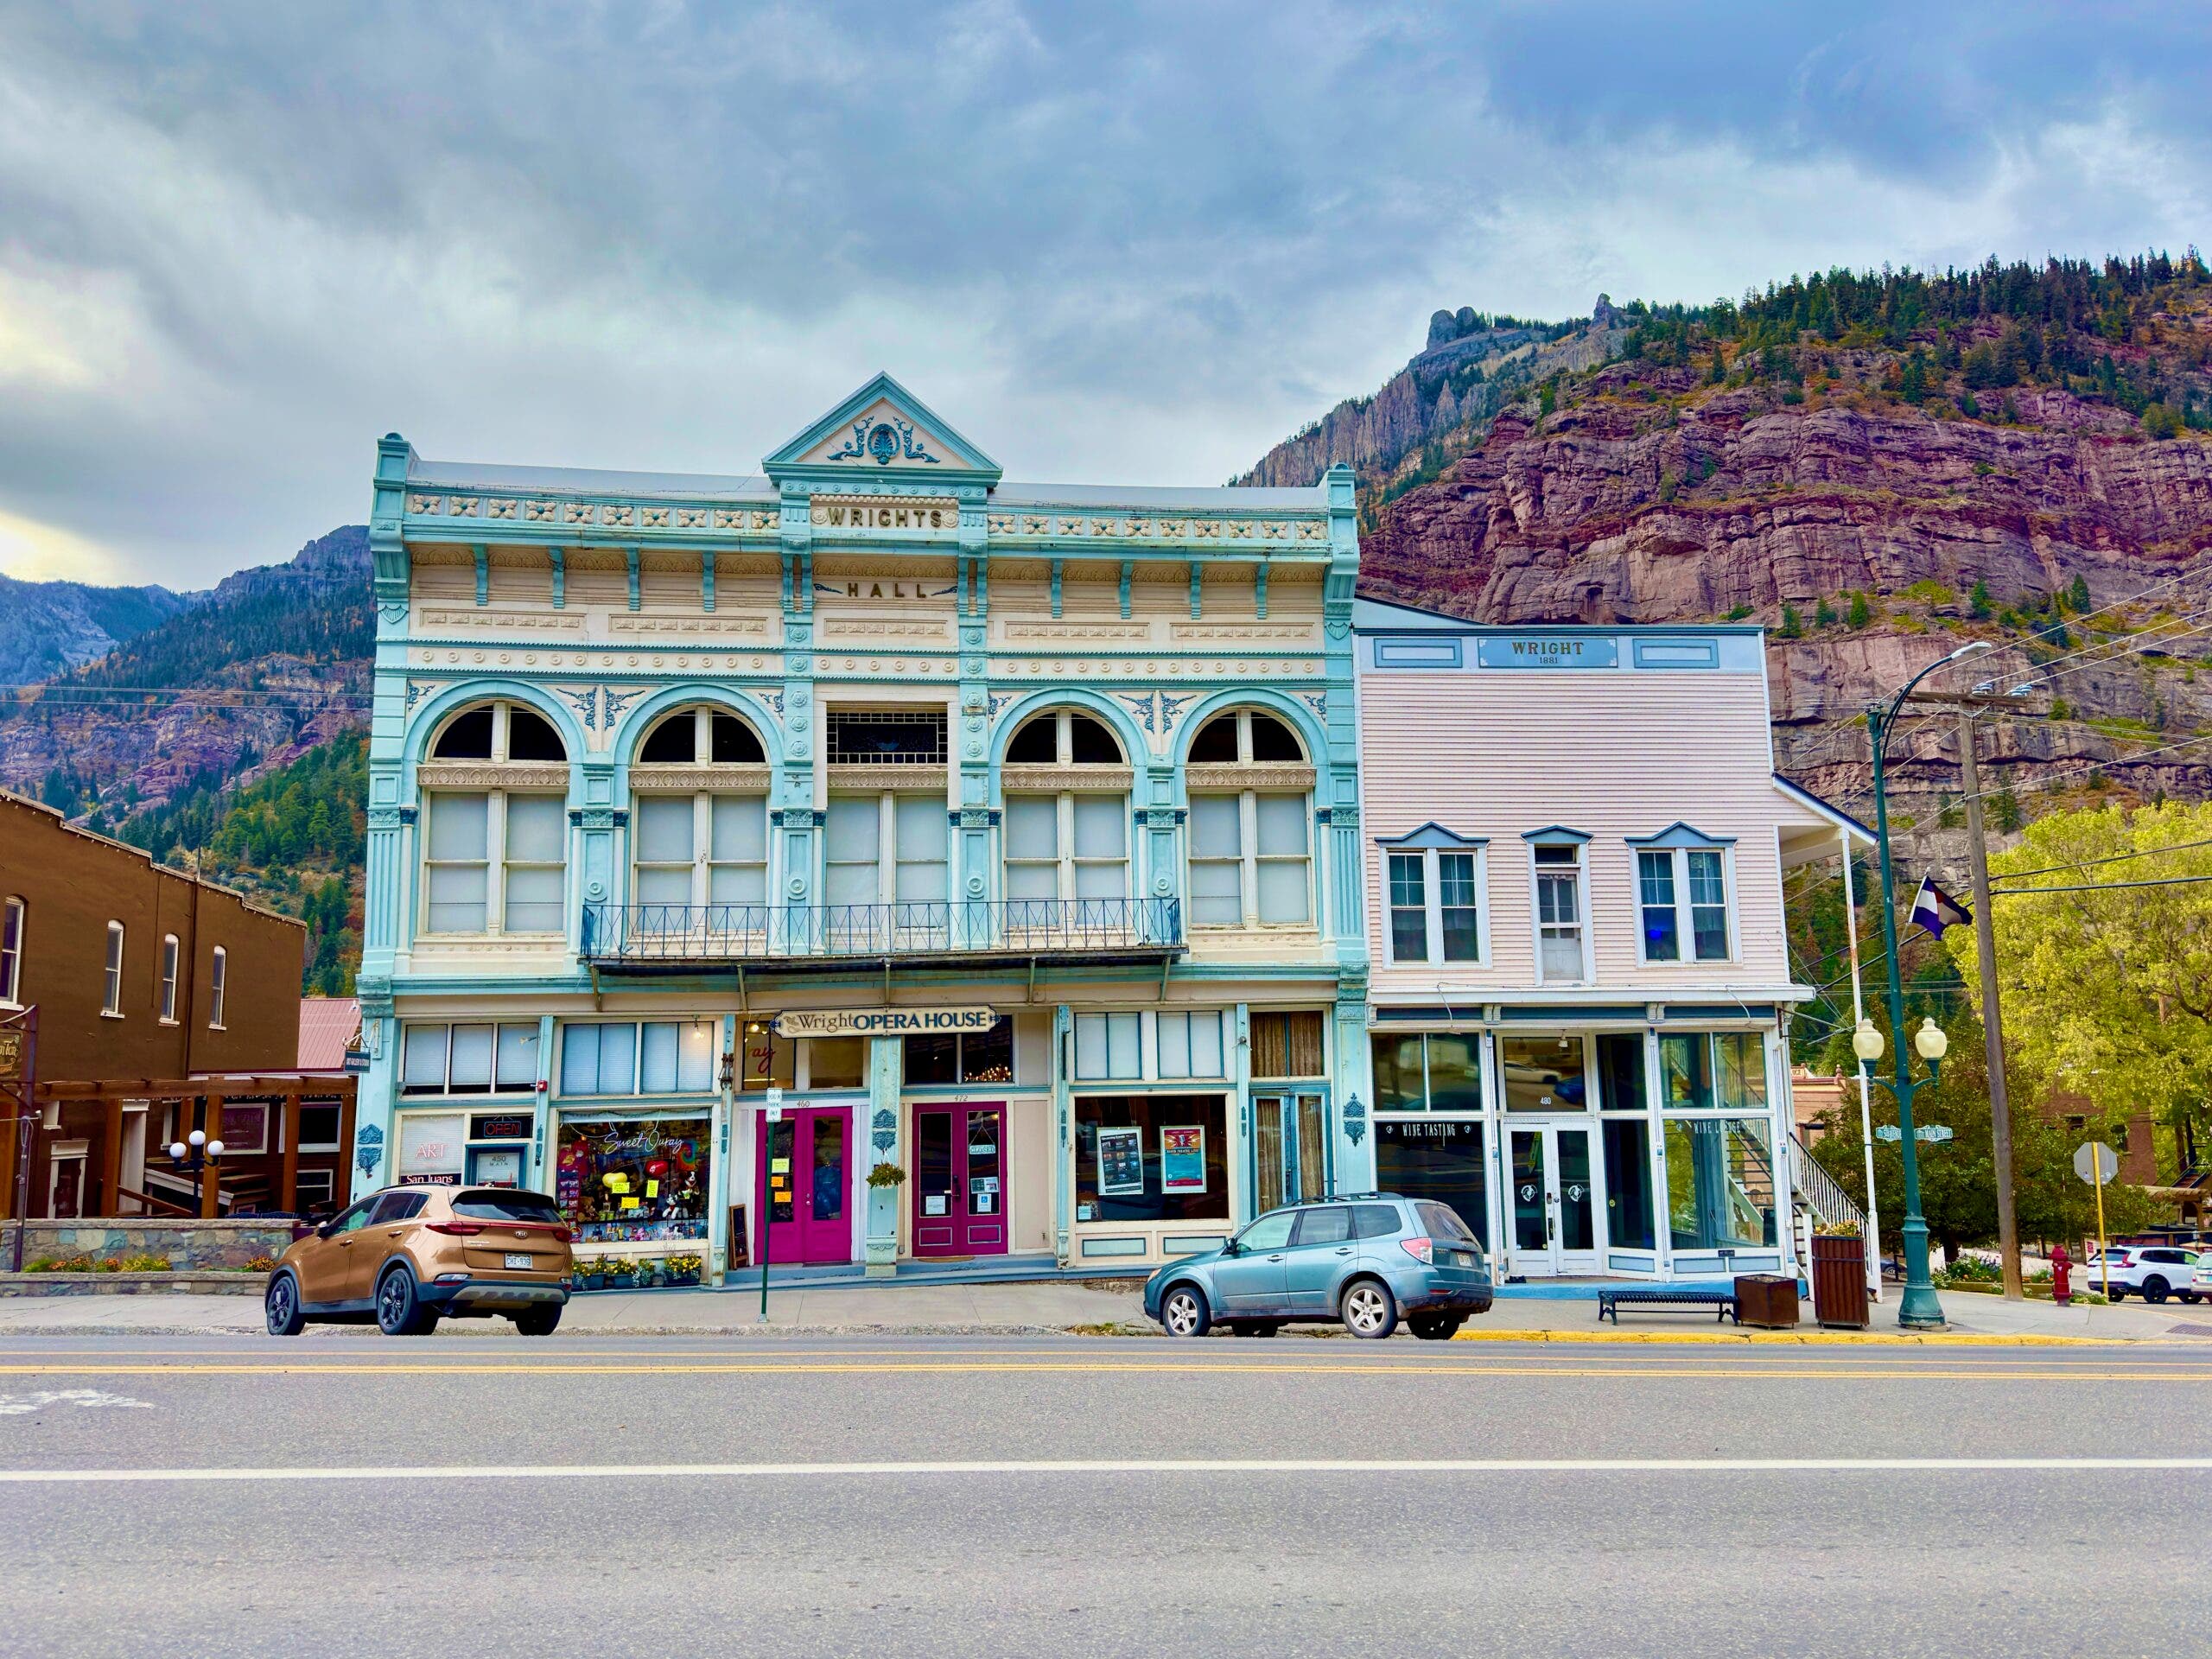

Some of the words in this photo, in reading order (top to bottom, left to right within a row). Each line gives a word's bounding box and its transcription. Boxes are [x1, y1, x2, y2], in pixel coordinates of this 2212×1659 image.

[828, 507, 942, 528] WRIGHTS
[848, 582, 926, 599] HALL
[1511, 641, 1585, 655] WRIGHT
[797, 1012, 854, 1033] Wright
[854, 1014, 921, 1030] OPERA
[925, 1012, 987, 1028] HOUSE
[485, 1123, 520, 1135] OPEN
[1403, 1123, 1421, 1137] WINE
[1424, 1123, 1456, 1140] TASTING
[1694, 1122, 1713, 1134] WINE
[1924, 1129, 1936, 1138] MAIN
[1937, 1128, 1953, 1138] STREET
[605, 1131, 644, 1154] Sweet
[645, 1131, 684, 1154] Ouray
[416, 1144, 448, 1158] ART
[406, 1175, 424, 1184] San
